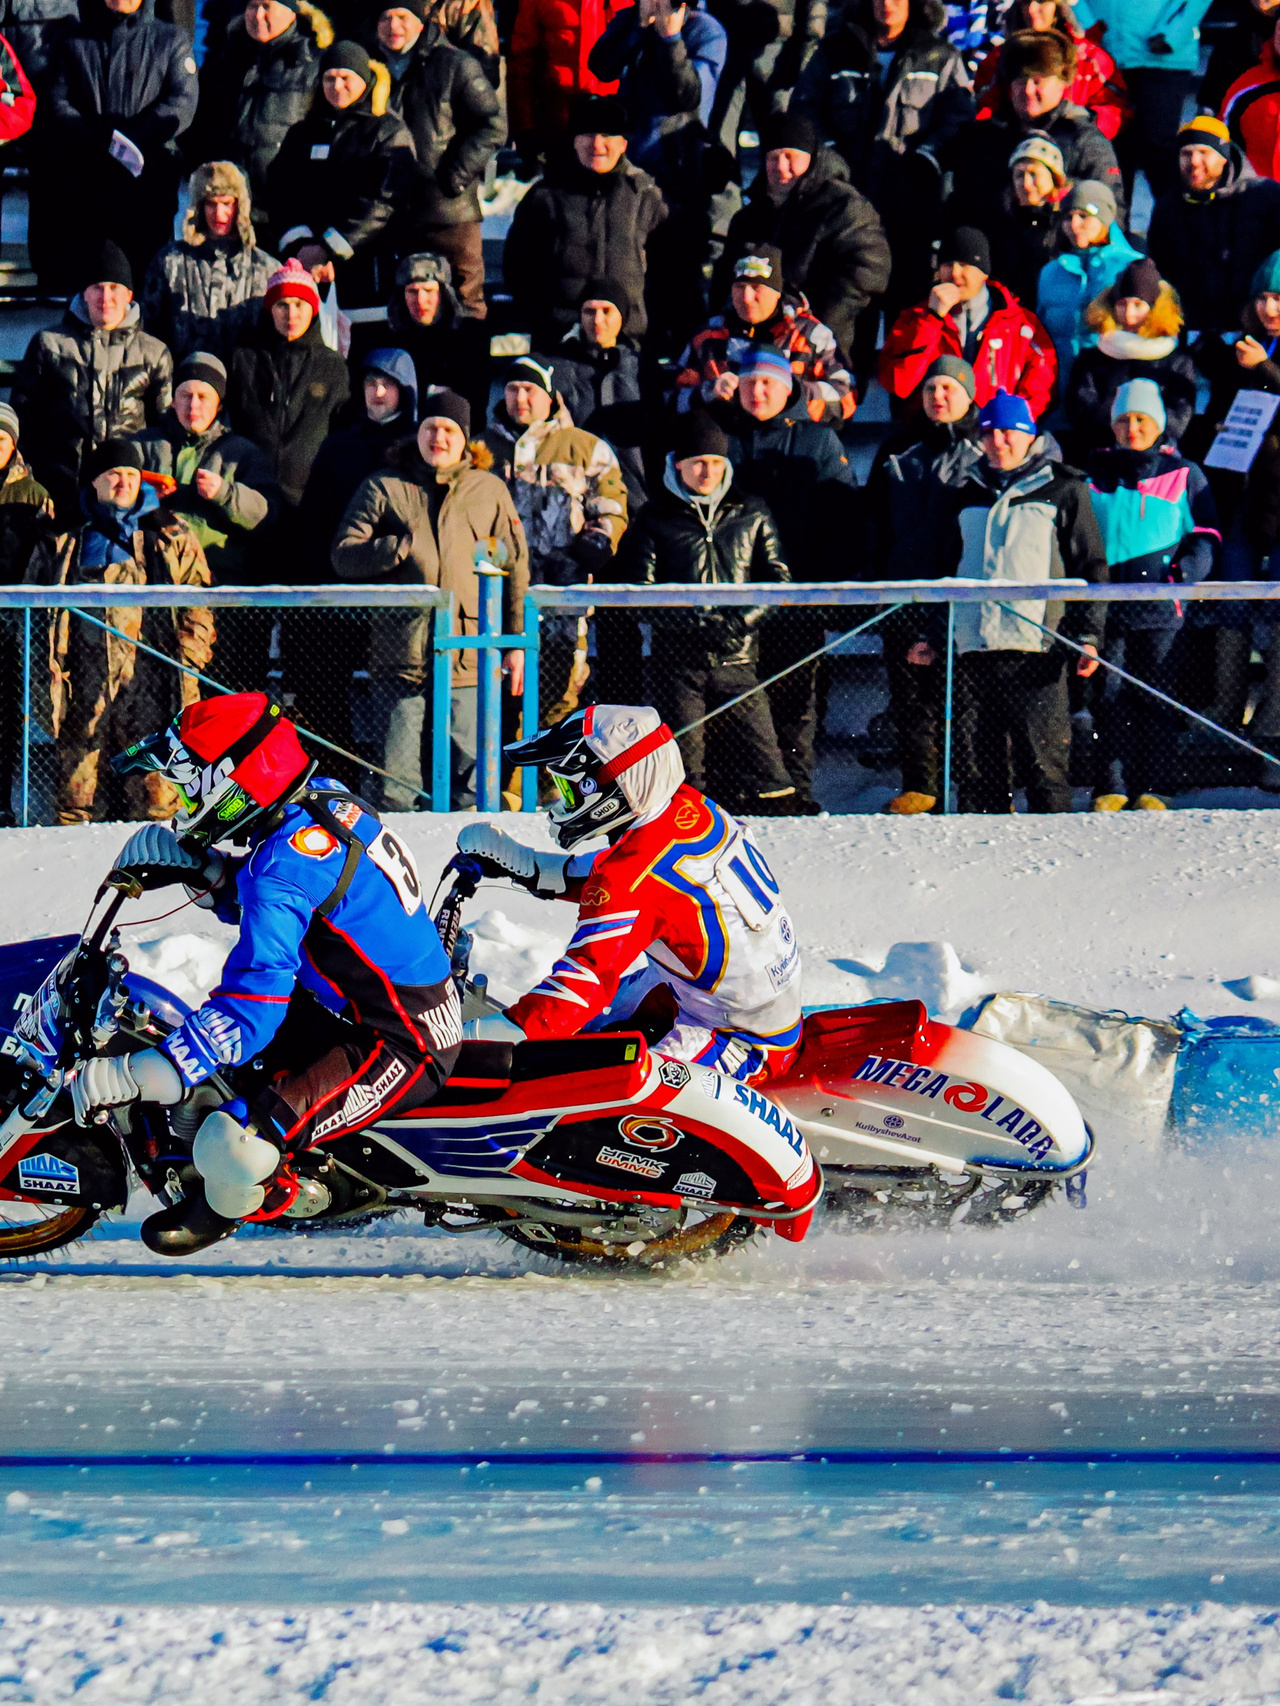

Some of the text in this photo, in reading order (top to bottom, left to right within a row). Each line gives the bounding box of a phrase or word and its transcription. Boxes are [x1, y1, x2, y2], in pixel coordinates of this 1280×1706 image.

[220, 799, 243, 820] SHOEI
[593, 801, 616, 818] SHOEI
[381, 832, 419, 898] 3
[728, 838, 780, 915] 10
[166, 1028, 208, 1083] HAAZ
[375, 1063, 402, 1096] SHAAZ
[734, 1083, 804, 1158] SHAAZ
[851, 1055, 1055, 1161] MEGA LADA
[855, 1120, 922, 1144] KuibyshevAzot
[598, 1155, 661, 1177] UMMC
[23, 1180, 77, 1193] SHAAZ
[674, 1185, 712, 1198] SHAAZ
